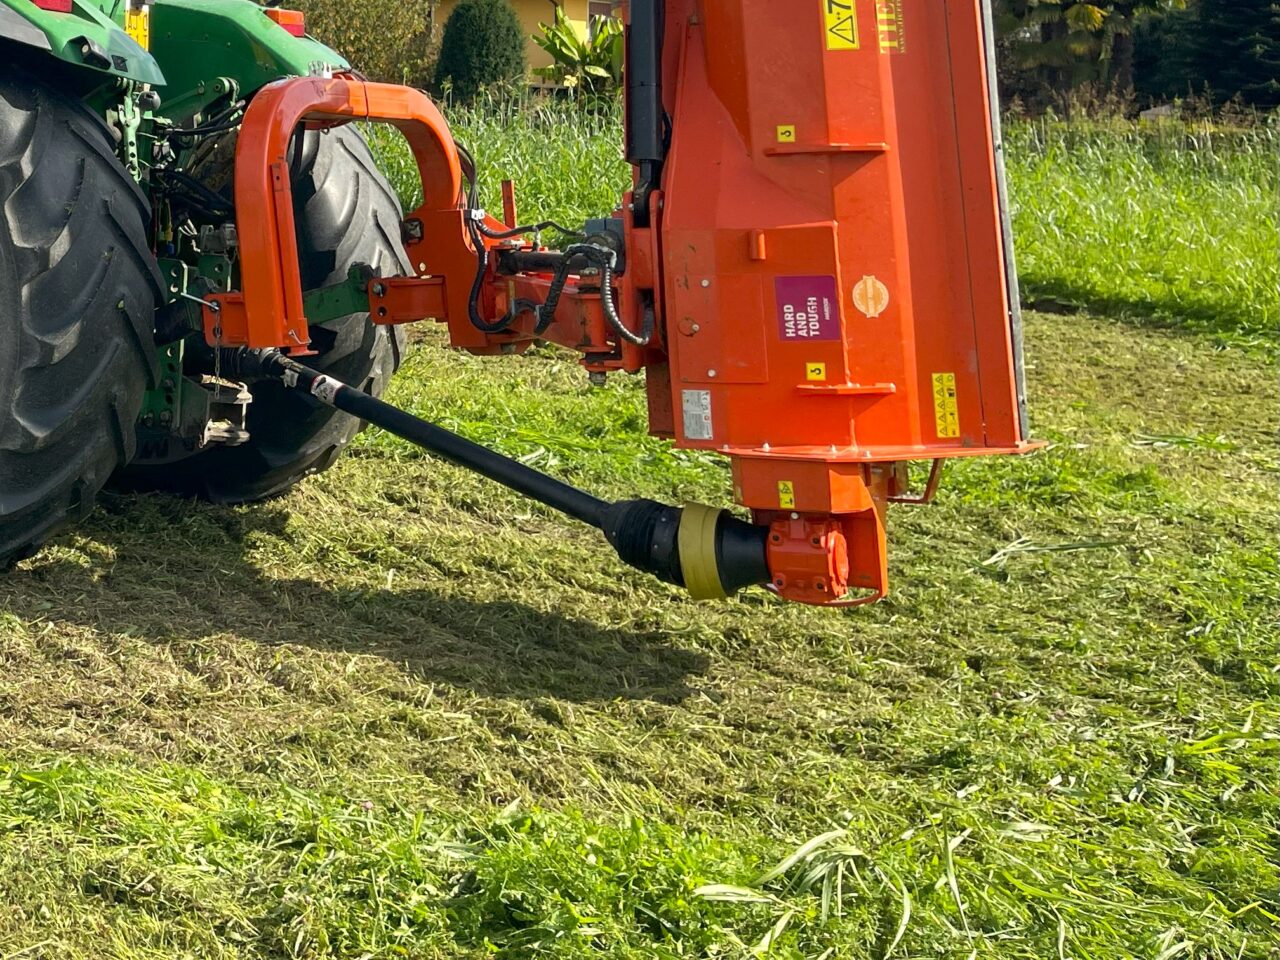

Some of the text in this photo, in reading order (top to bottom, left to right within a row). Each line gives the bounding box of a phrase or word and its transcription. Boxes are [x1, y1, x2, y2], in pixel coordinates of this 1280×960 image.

[783, 304, 796, 337] HARD
[796, 312, 808, 337] AND
[807, 297, 820, 337] TOUGH
